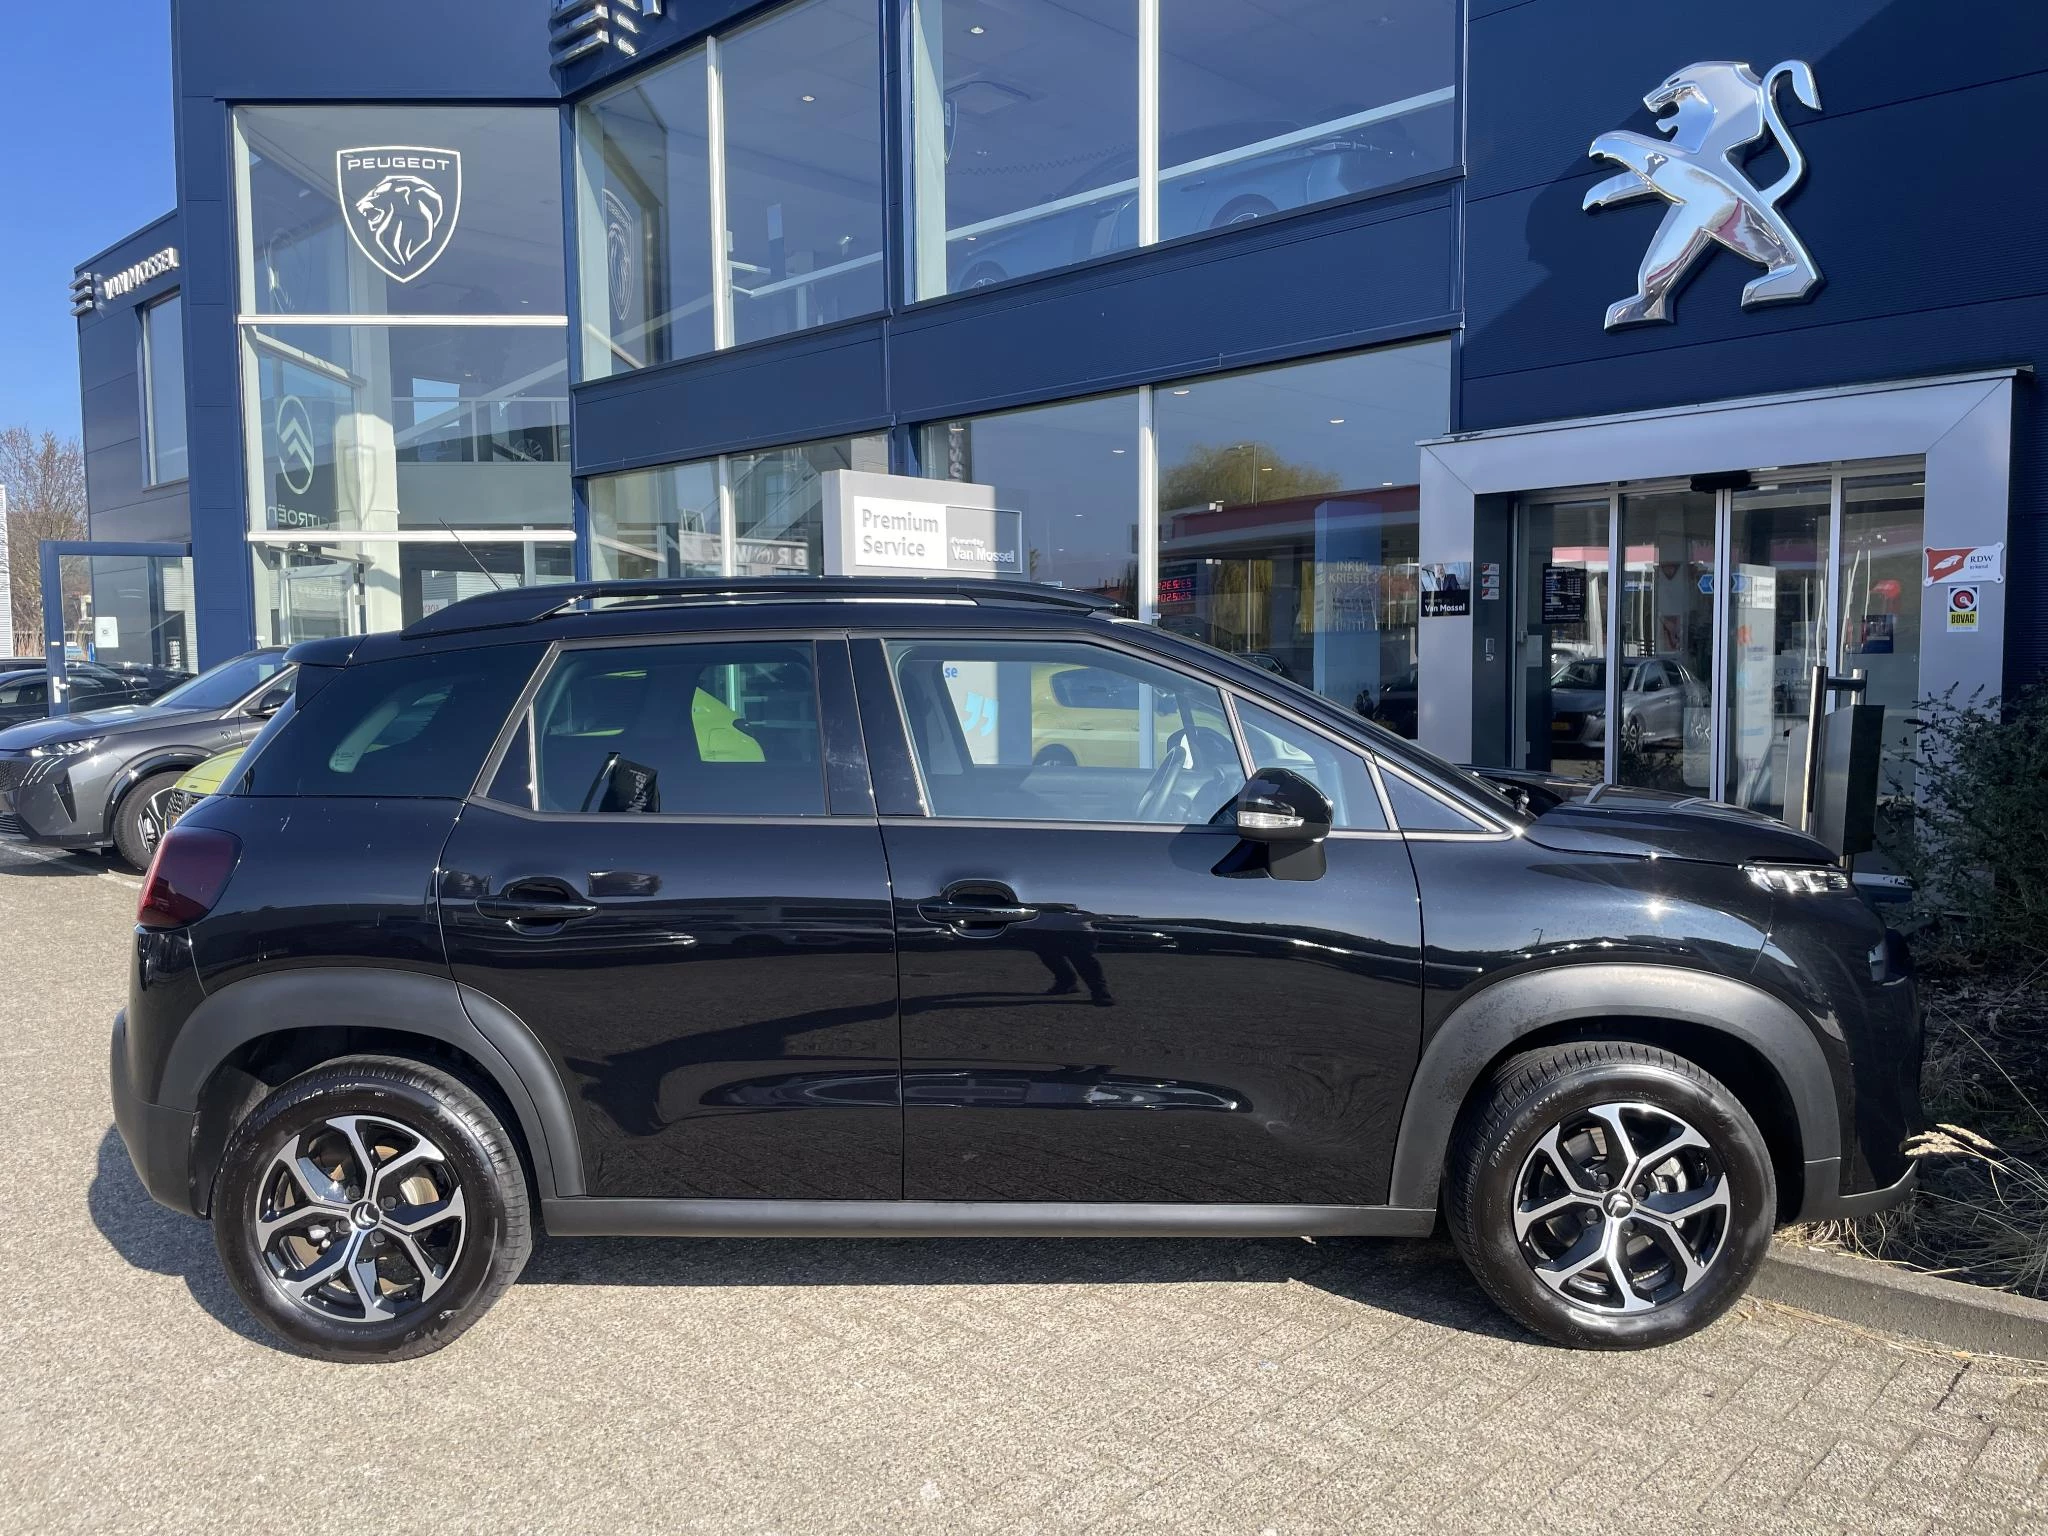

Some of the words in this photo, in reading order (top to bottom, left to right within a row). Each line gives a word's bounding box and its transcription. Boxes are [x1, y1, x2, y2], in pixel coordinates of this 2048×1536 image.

[347, 157, 450, 171] PEUGEOT
[862, 508, 939, 533] Premium
[863, 535, 926, 557] Service
[951, 545, 974, 561] Van
[976, 547, 1015, 563] Mossel
[1970, 554, 1994, 563] RDW
[1439, 603, 1466, 612] Mossel
